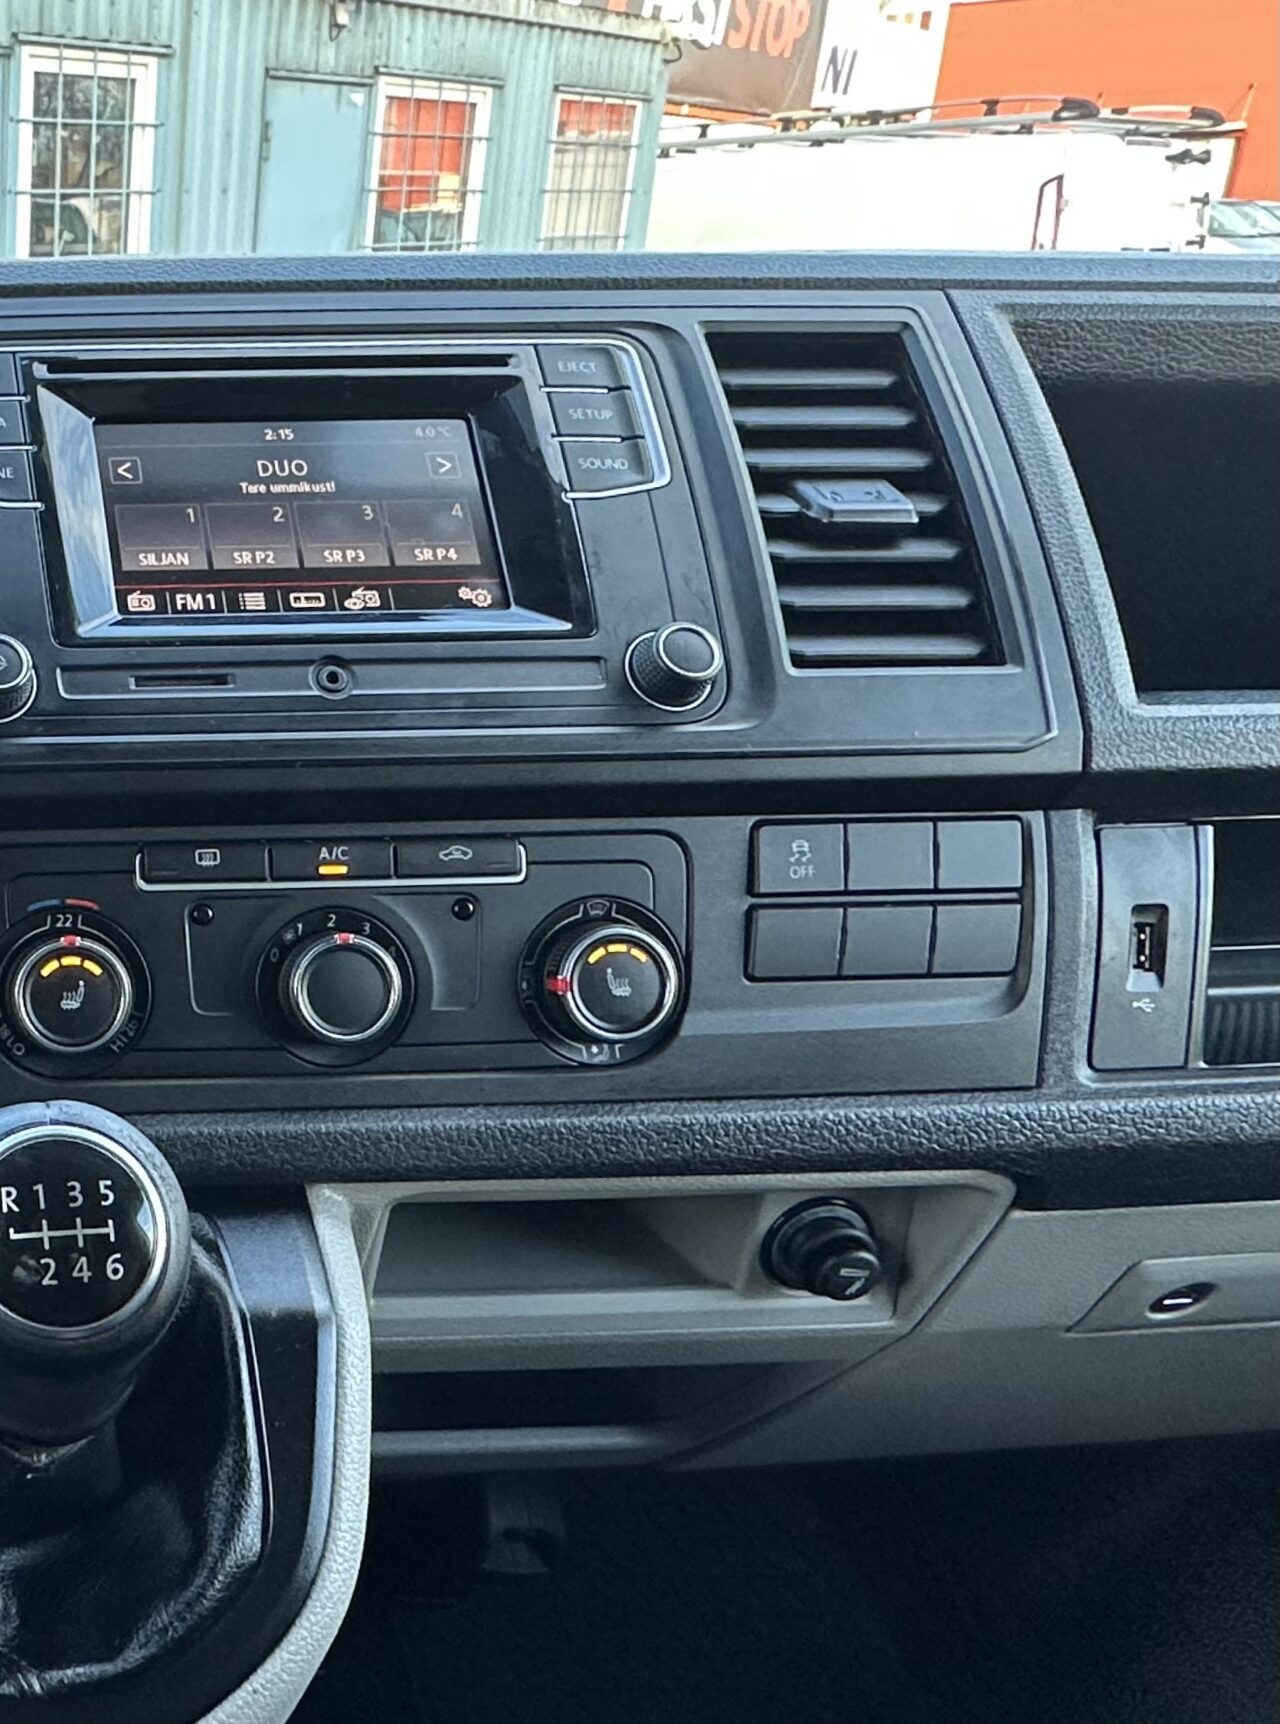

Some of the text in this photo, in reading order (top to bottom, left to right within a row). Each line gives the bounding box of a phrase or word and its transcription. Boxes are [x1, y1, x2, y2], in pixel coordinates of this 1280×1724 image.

[557, 360, 598, 373] EJECT
[568, 408, 614, 420] SETUP
[263, 428, 295, 441] 2:15
[256, 459, 309, 477] DUO
[578, 457, 629, 470] SOUND
[240, 482, 267, 494] Tere
[186, 507, 196, 523] 1
[272, 506, 285, 523] 2
[361, 504, 375, 521] 3
[450, 502, 464, 519] 4
[138, 551, 190, 567] SILJAN
[232, 550, 276, 565] SR P2
[323, 549, 366, 563] SR P3
[414, 547, 458, 562] SR P4
[175, 593, 204, 611] FM
[319, 847, 349, 861] A/C
[789, 864, 816, 879] OFF
[55, 914, 73, 928] 22
[326, 913, 336, 927] 2
[296, 922, 303, 936] 1
[361, 922, 371, 935] 3
[0, 1179, 115, 1213] R 1 3 5
[40, 1252, 124, 1286] 2 4 6
